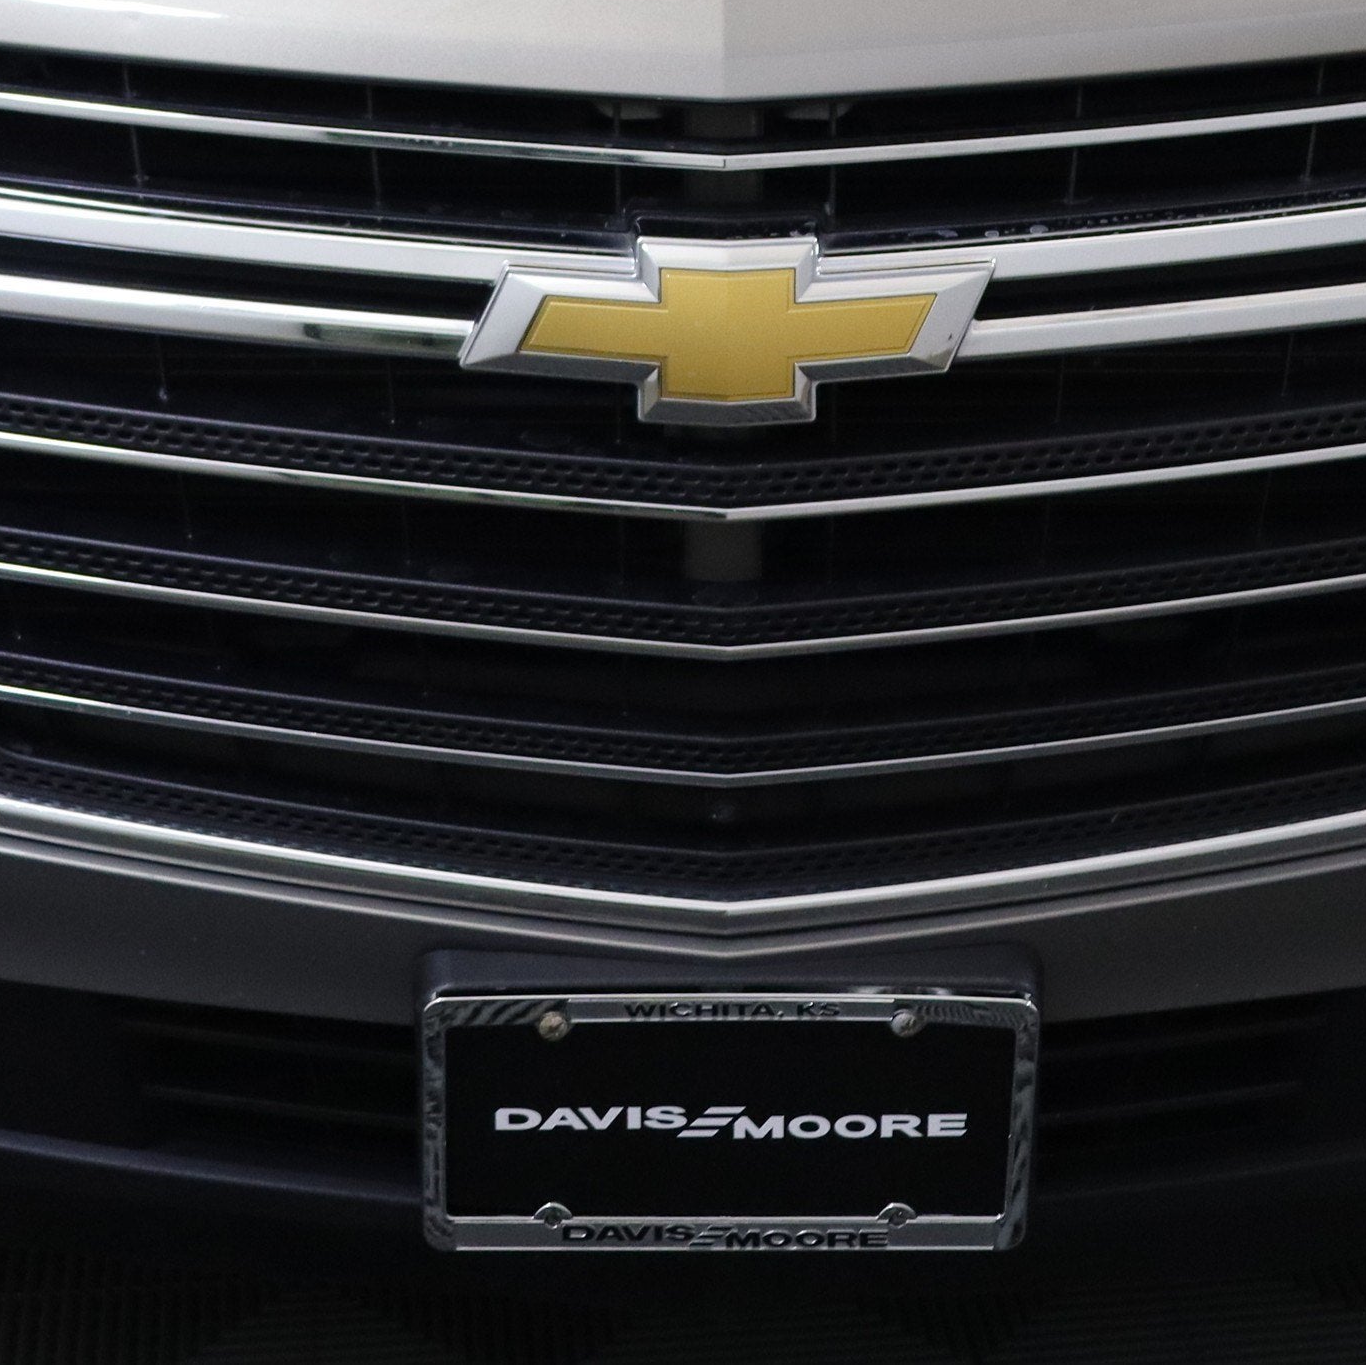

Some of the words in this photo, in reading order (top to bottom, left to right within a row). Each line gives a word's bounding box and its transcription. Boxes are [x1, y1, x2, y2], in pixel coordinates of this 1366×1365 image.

[795, 1001, 841, 1017] KS
[494, 1105, 687, 1132] DAVIS
[732, 1112, 969, 1140] MOORE
[561, 1224, 696, 1243] DAVIS
[724, 1228, 890, 1250] MOORE
